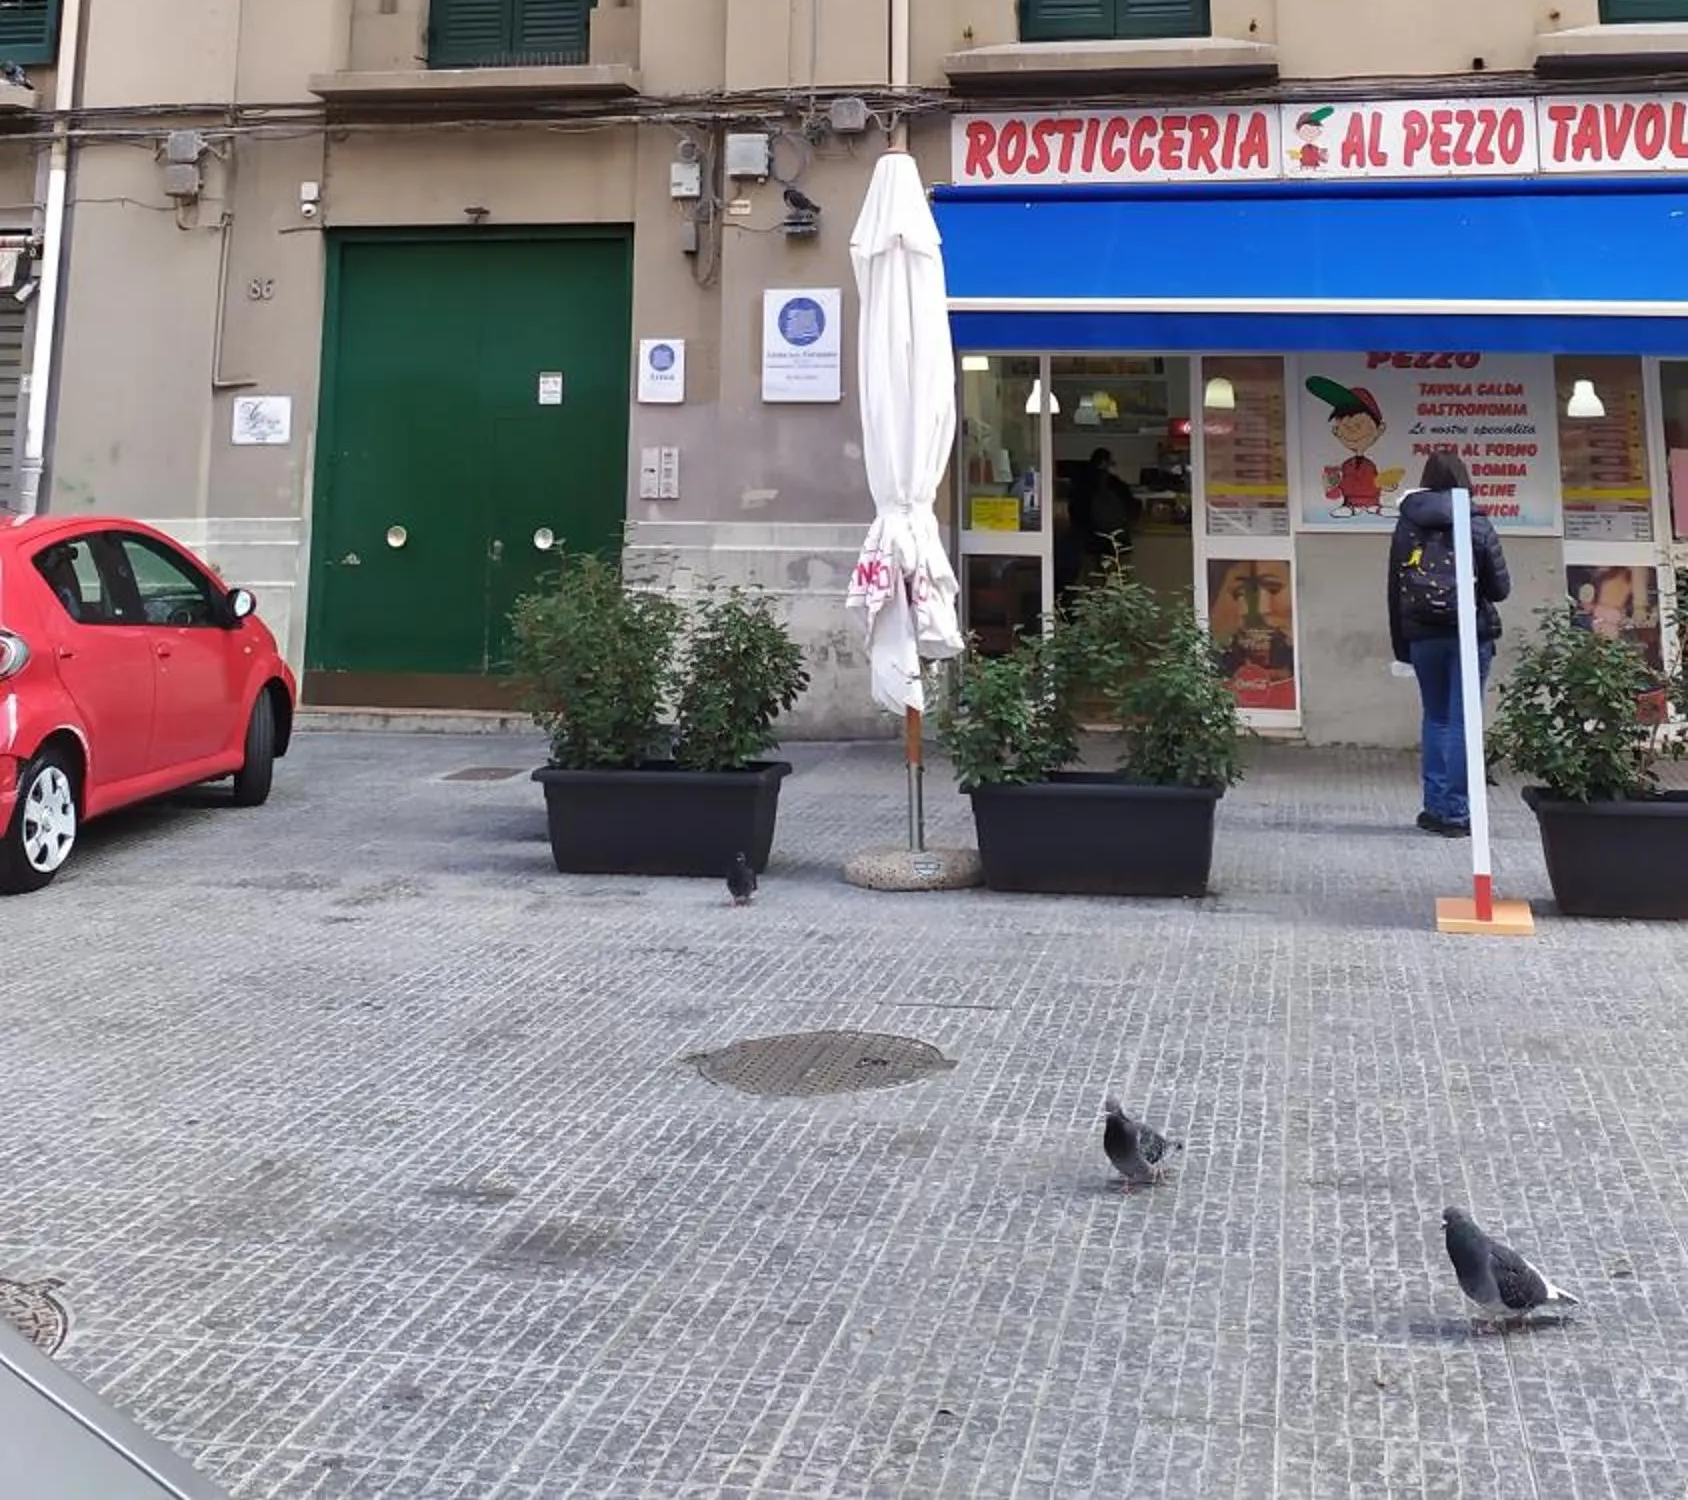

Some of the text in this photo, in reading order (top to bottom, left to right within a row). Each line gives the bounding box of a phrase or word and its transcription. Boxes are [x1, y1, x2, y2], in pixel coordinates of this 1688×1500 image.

[966, 112, 1268, 179] ROSTICCERIA
[1341, 111, 1388, 168] AL
[1403, 107, 1524, 167] PEZZO
[1419, 382, 1524, 396] TAVOLA CALDA
[1417, 403, 1528, 417] GASTRONOMIA
[1409, 421, 1425, 435] Le
[1430, 424, 1468, 435] nostre
[1461, 443, 1482, 457] AL
[1485, 443, 1538, 457] FORNO
[1472, 463, 1527, 477] BOMBA
